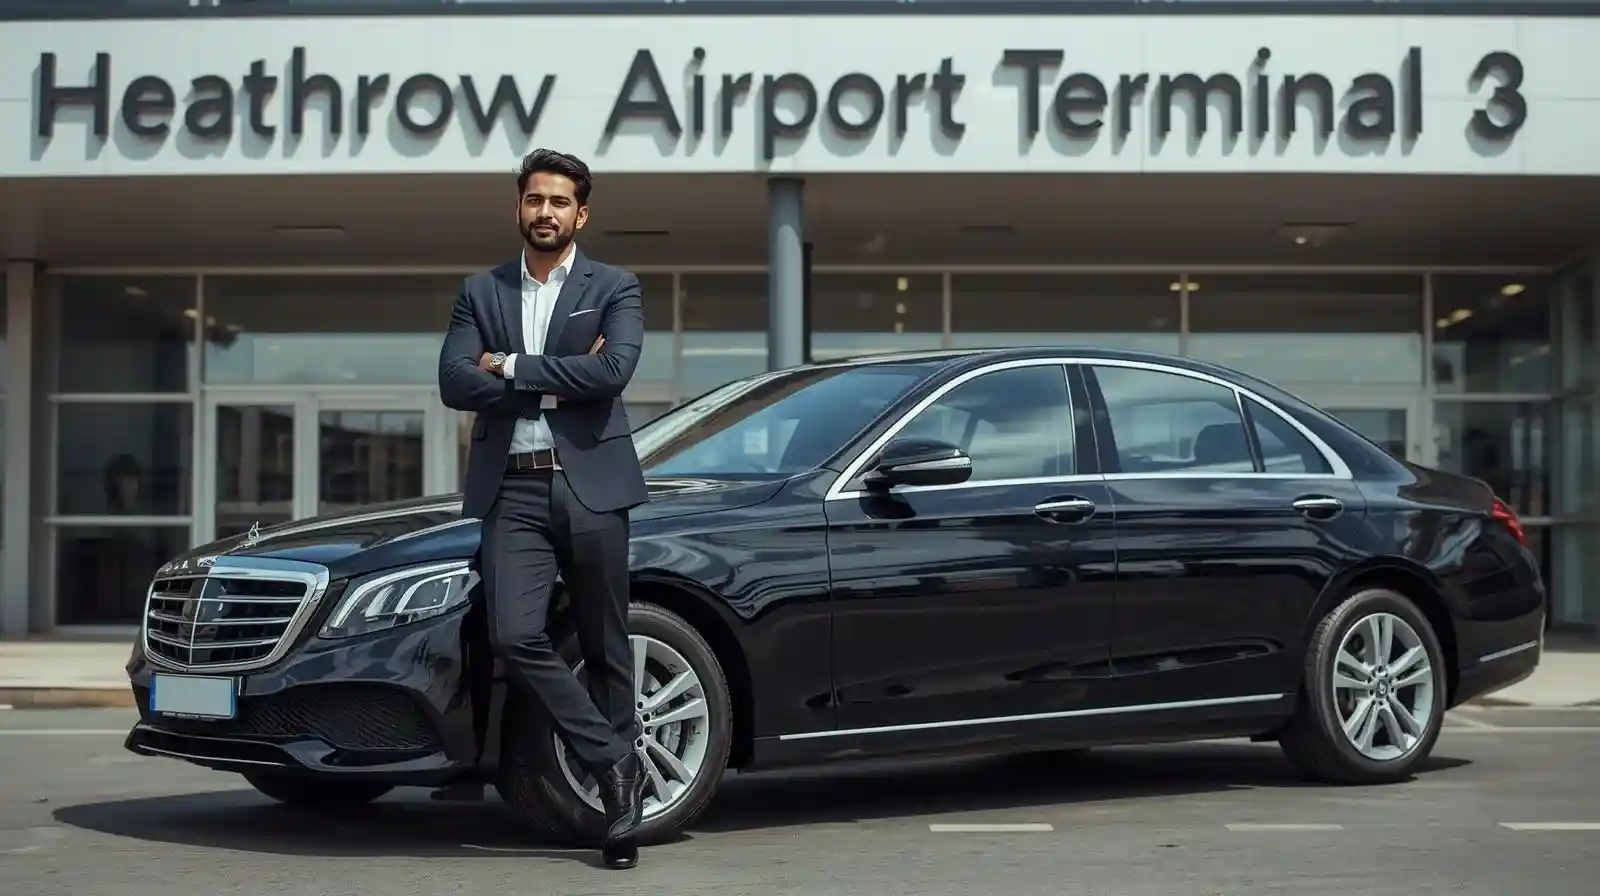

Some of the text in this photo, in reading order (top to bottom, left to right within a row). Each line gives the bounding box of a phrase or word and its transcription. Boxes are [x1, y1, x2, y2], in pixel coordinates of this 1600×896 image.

[37, 46, 1528, 161] Heathrow Airport Terminal 3
